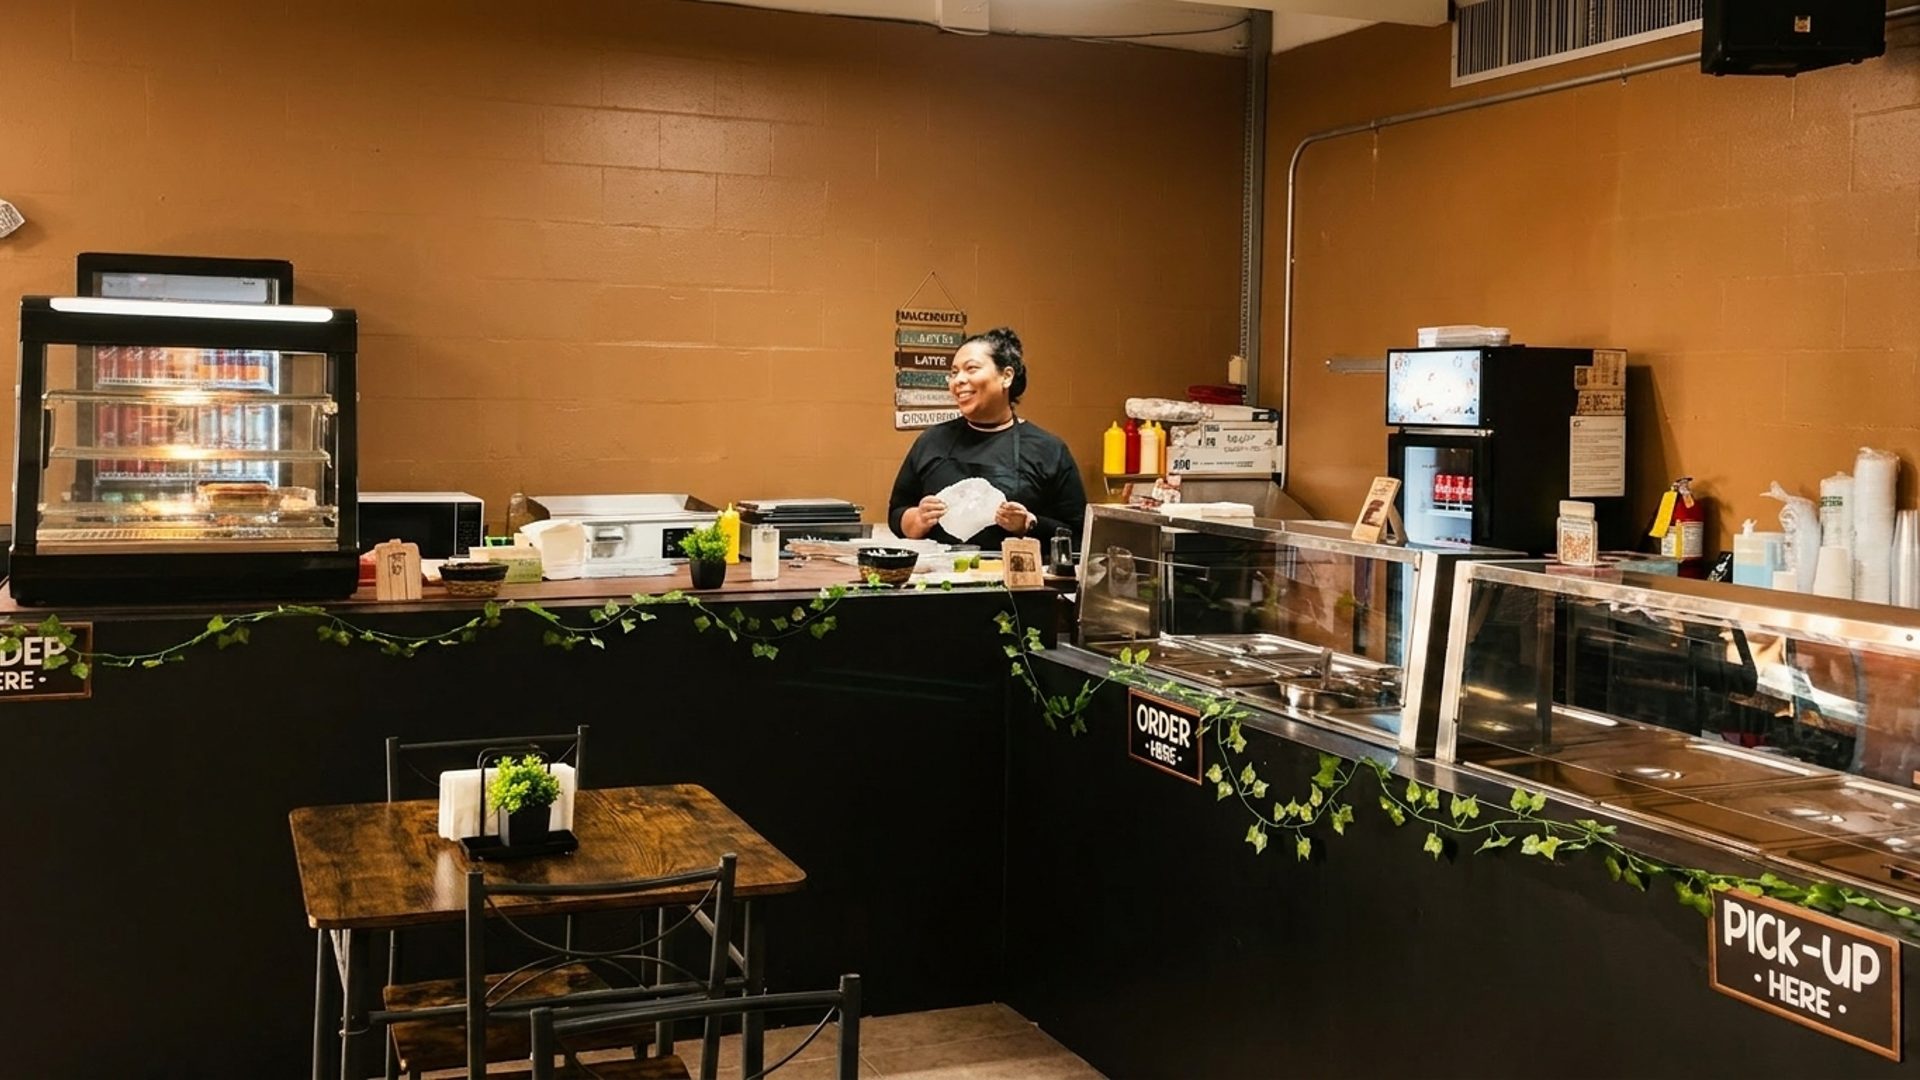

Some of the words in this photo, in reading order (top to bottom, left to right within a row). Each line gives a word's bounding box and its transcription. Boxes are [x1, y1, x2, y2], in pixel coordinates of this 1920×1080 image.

[1137, 704, 1191, 748] ORDER
[1724, 900, 1880, 992] PICK-UP
[1769, 969, 1831, 1018] HERE
